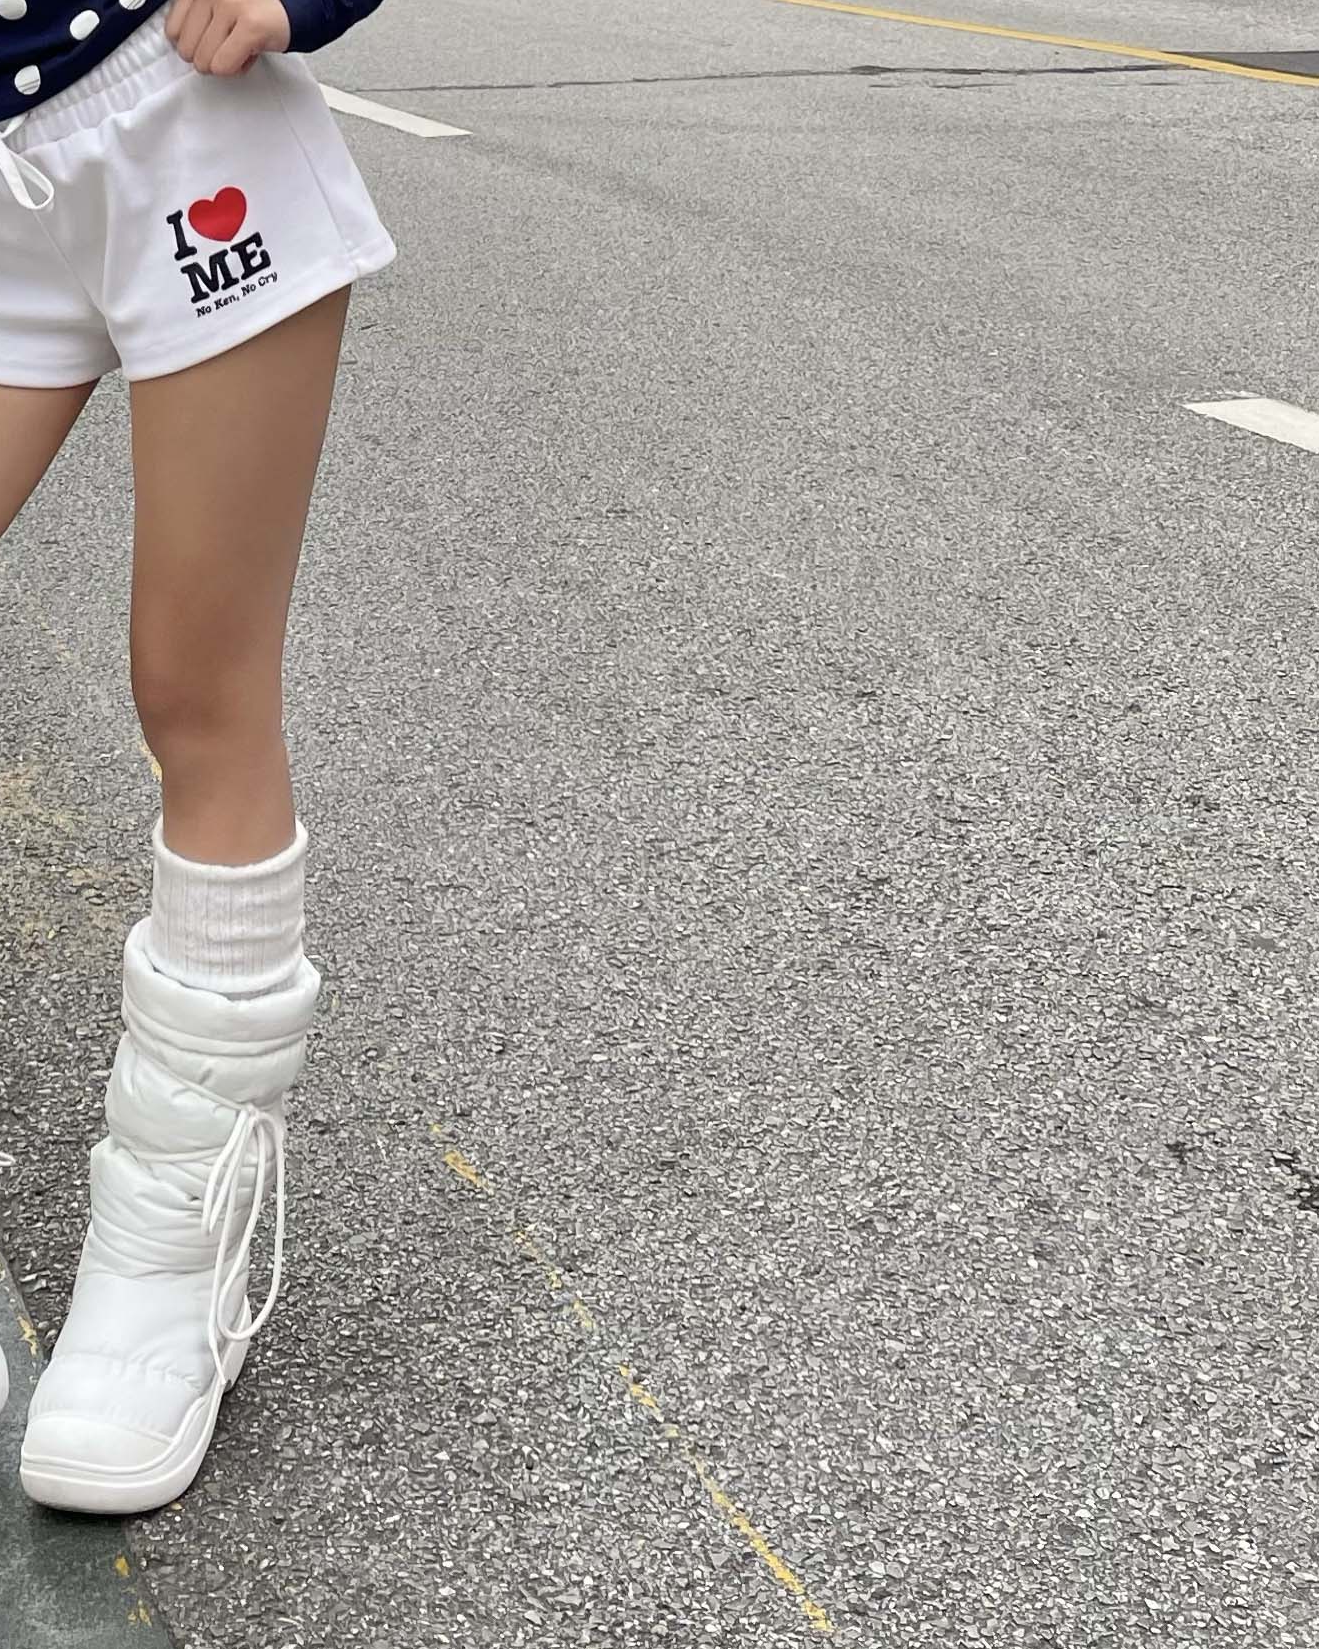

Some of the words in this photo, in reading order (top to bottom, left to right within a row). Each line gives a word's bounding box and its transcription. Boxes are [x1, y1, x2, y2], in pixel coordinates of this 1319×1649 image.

[166, 209, 198, 261] I
[181, 231, 271, 304] ME
[196, 306, 212, 317] No
[214, 294, 240, 311] Ken,
[241, 284, 256, 297] No
[258, 271, 278, 287] Cry
